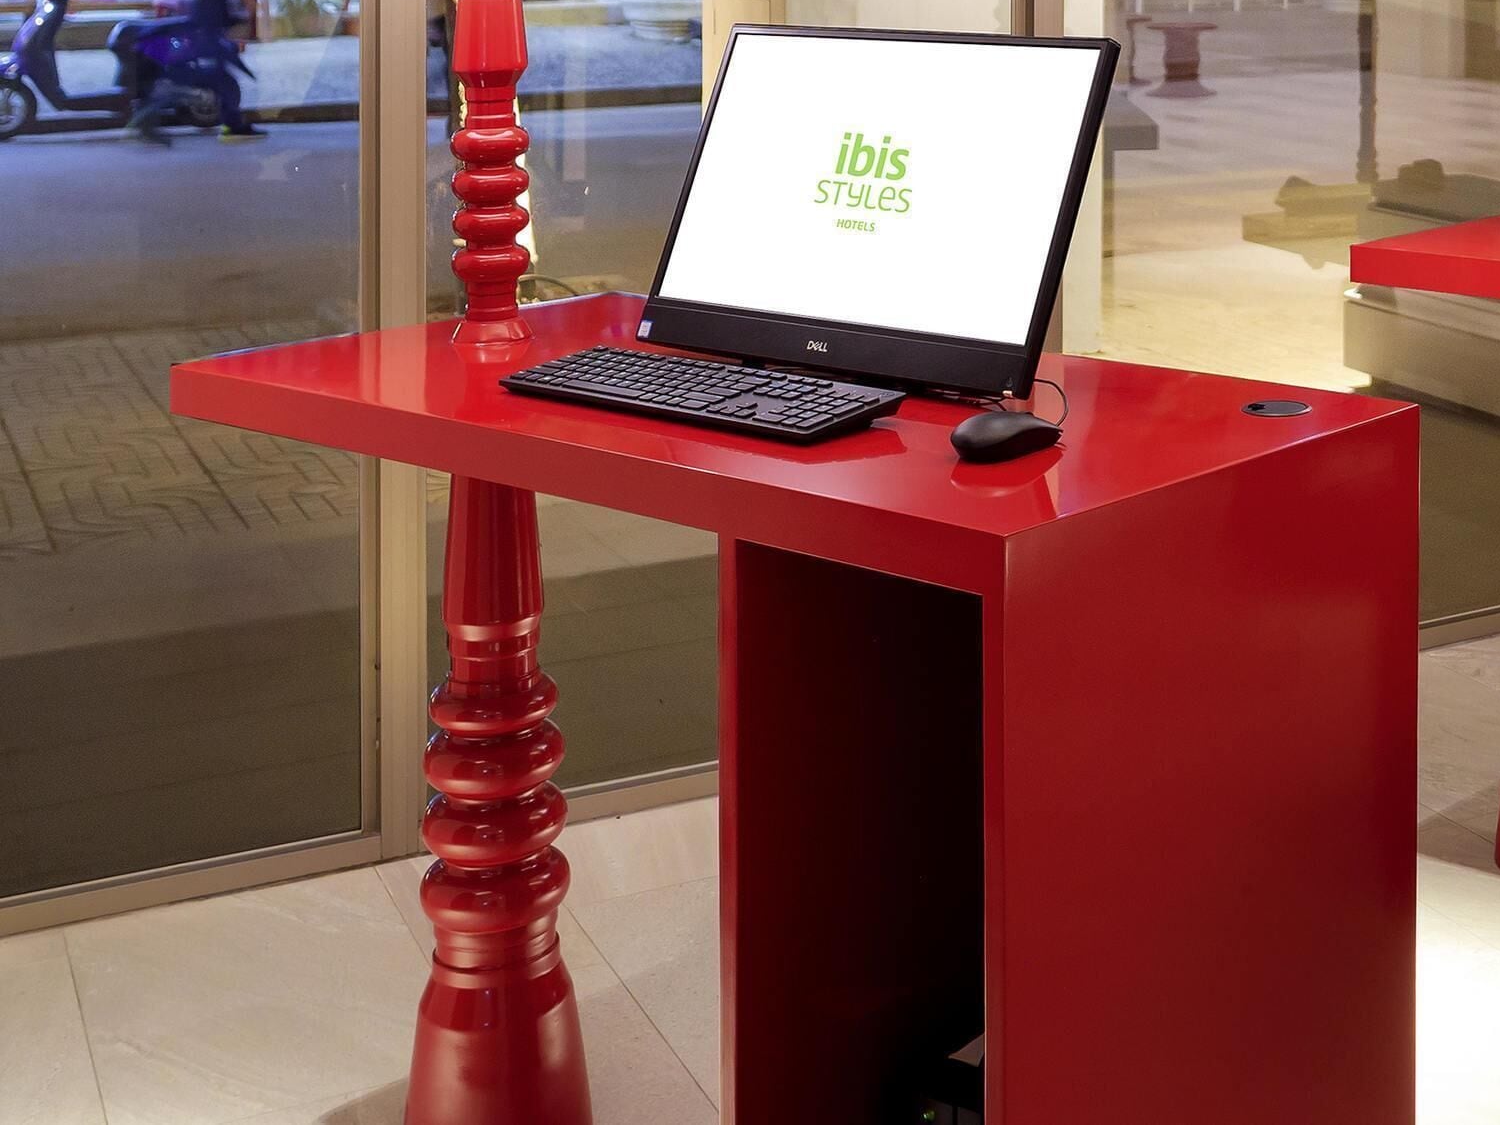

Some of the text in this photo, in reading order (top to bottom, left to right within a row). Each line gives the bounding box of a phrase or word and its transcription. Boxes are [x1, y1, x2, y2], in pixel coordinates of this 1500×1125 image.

[835, 132, 910, 180] ibis
[836, 218, 876, 232] HOTELS
[806, 340, 828, 353] DELL
